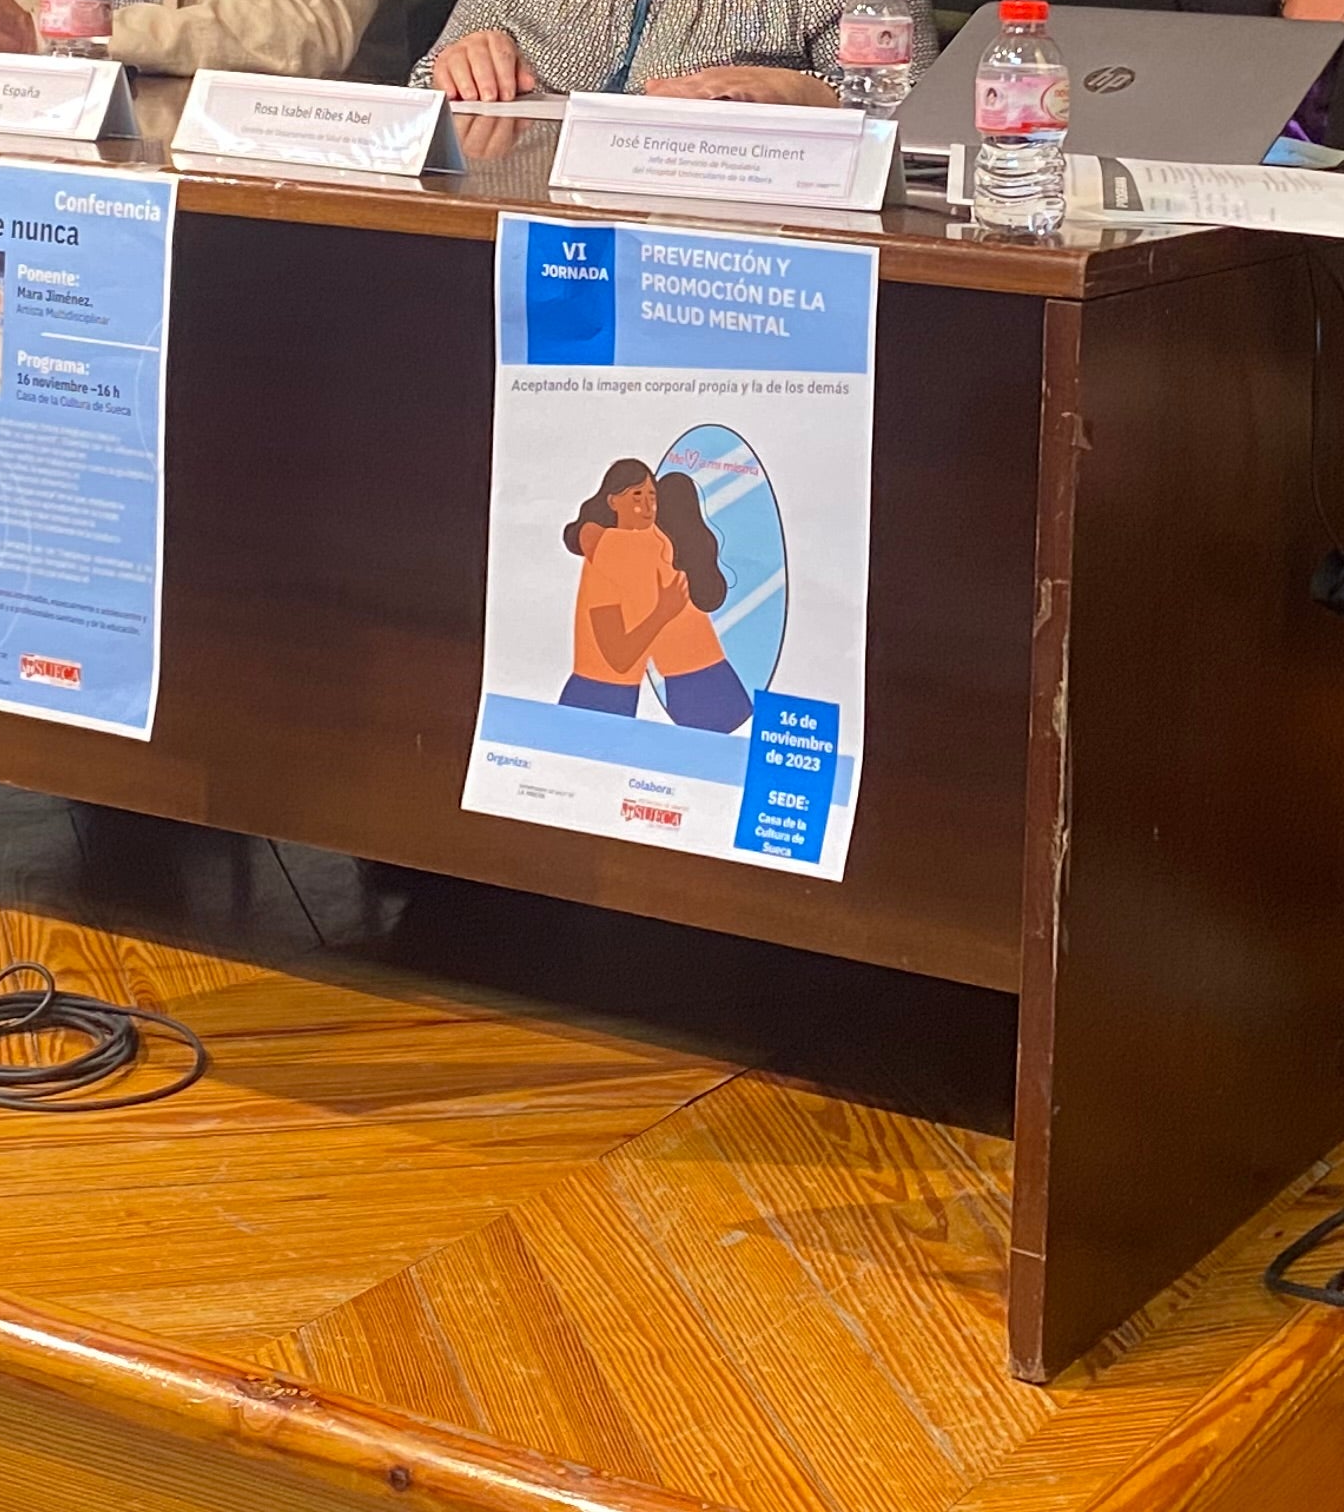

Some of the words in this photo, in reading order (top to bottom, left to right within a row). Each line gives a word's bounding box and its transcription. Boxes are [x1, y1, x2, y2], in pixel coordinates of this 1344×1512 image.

[2, 83, 41, 99] España
[1086, 67, 1134, 93] hp
[254, 102, 278, 116] Rosa
[281, 105, 313, 119] Isabel
[314, 108, 344, 123] Ribes
[345, 111, 372, 125] Abel
[609, 134, 640, 151] José
[643, 136, 696, 154] Enrique
[699, 140, 747, 157] Romeu
[751, 144, 806, 161] Climent
[54, 191, 161, 221] Conferencia
[11, 219, 79, 246] nunca
[562, 241, 586, 261] VI
[641, 244, 772, 276] PREVENCIÓN
[776, 257, 791, 278] Y
[17, 263, 80, 287] Ponente:
[541, 263, 610, 282] JORNADA
[16, 286, 43, 301] Mara
[44, 289, 93, 308] Jiménez.
[641, 272, 763, 305] PROMOCIÓN
[768, 287, 796, 308] DE
[800, 290, 826, 313] LA
[641, 300, 705, 327] SALUD
[709, 309, 791, 337] MENTAL
[17, 349, 90, 375] Programa:
[17, 373, 31, 386] 16
[32, 376, 89, 394] noviembre
[112, 385, 121, 399] h
[511, 378, 579, 394] Aceptando
[582, 378, 593, 392] la
[596, 378, 641, 394] imagen
[644, 379, 696, 395] corporal
[698, 379, 737, 396] propia
[741, 382, 748, 396] y
[752, 380, 763, 393] la
[766, 380, 782, 394] de
[784, 380, 804, 394] los
[807, 380, 850, 395] demás
[16, 389, 37, 402] Casa
[38, 394, 49, 405] de
[50, 395, 58, 406] la
[60, 396, 91, 411] Cultura
[92, 401, 104, 413] de
[105, 402, 132, 417] Sueca
[779, 710, 797, 727] 16
[799, 714, 817, 730] de
[760, 730, 833, 753] noviembre
[486, 751, 532, 769] Organiza:
[766, 749, 783, 766] de
[785, 752, 821, 772] 2023
[628, 778, 675, 797] Colabora:
[768, 790, 810, 812] SEDE:
[758, 812, 782, 827] Casa
[783, 816, 796, 829] de
[797, 818, 807, 832] la
[754, 826, 791, 843] Cultura
[791, 833, 805, 846] de
[762, 841, 792, 857] Sueca
